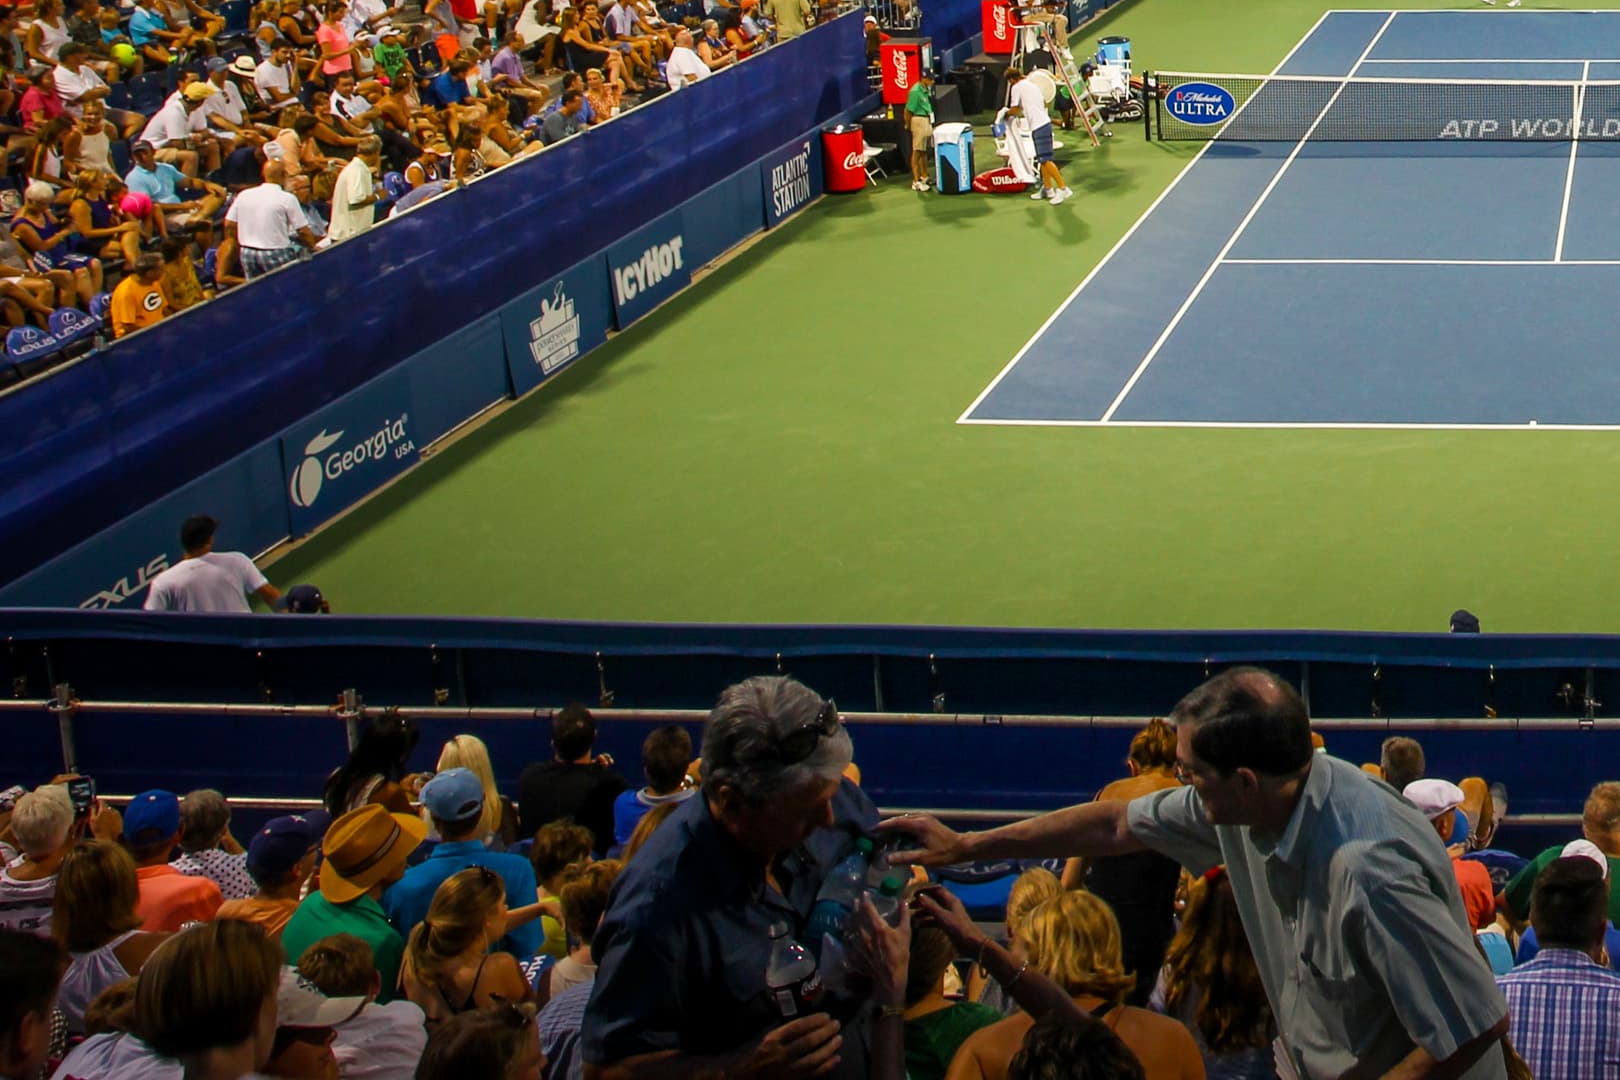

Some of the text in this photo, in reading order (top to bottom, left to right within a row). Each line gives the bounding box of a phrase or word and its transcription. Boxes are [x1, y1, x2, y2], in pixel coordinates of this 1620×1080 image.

[993, 4, 1006, 40] Coca-Cola
[893, 48, 908, 89] Coca-Cola
[1174, 102, 1227, 116] ULTRA
[1438, 119, 1499, 138] ATP
[772, 151, 809, 191] ATLANTIC
[773, 173, 810, 217] STATION
[613, 234, 684, 306] ICYHOT
[12, 337, 57, 356] LEXUS
[55, 315, 95, 340] LEXUS
[325, 418, 406, 480] Georgia
[394, 440, 416, 459] USA
[78, 553, 170, 610] EXUS
